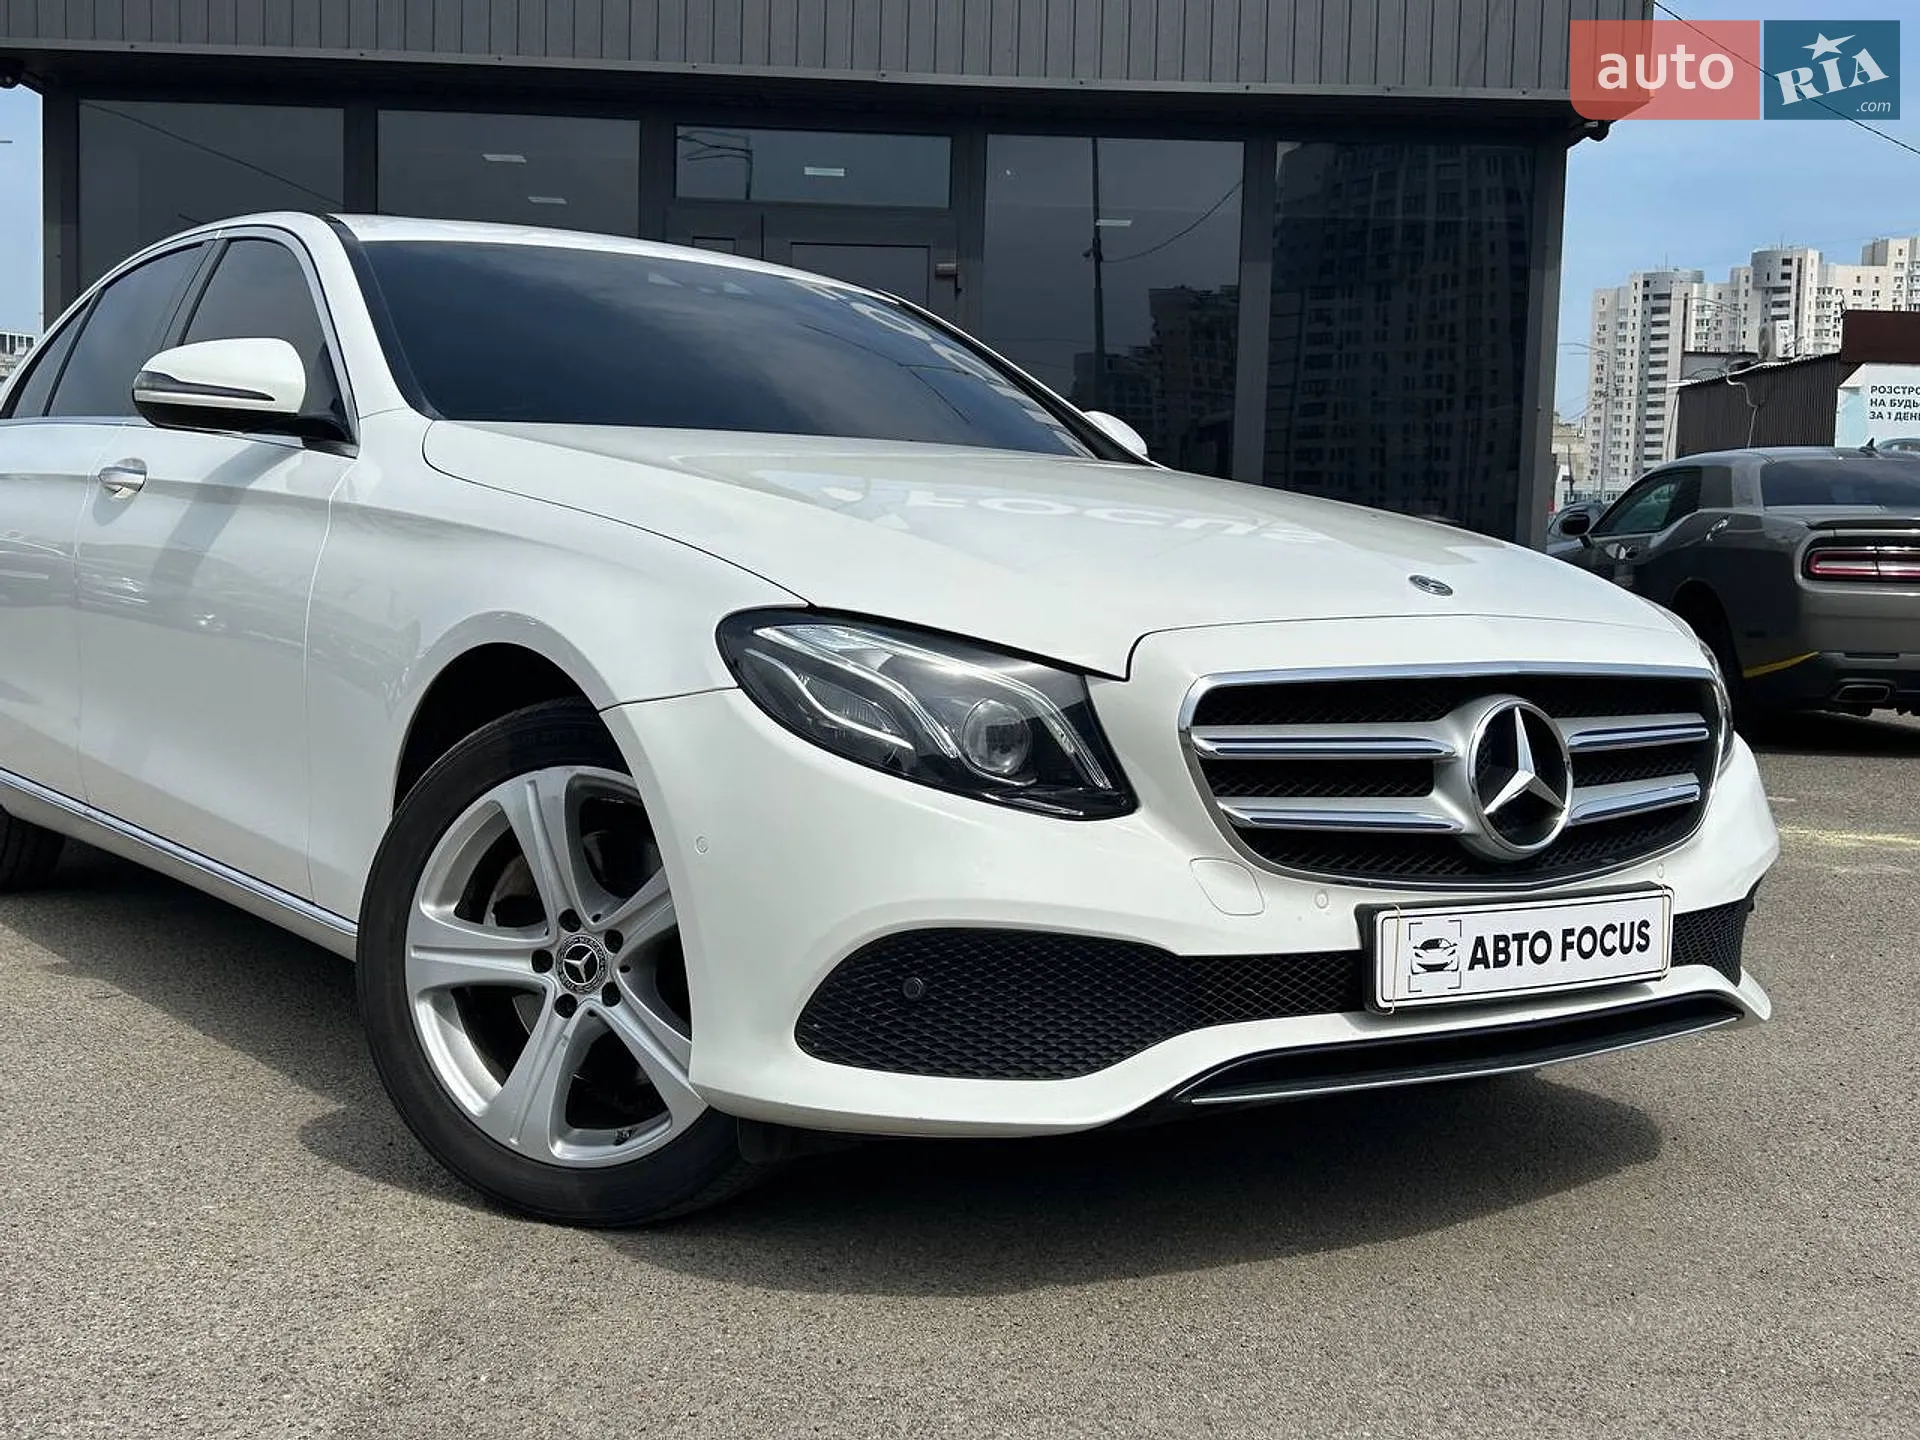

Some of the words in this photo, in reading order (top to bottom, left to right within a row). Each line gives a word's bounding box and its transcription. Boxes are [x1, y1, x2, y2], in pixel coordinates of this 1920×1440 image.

[1870, 398, 1886, 407] НА
[1869, 411, 1883, 419] ЗА
[1894, 411, 1920, 421] ДЕН
[1467, 930, 1552, 971] АВТО
[1561, 919, 1650, 962] FOCUS
